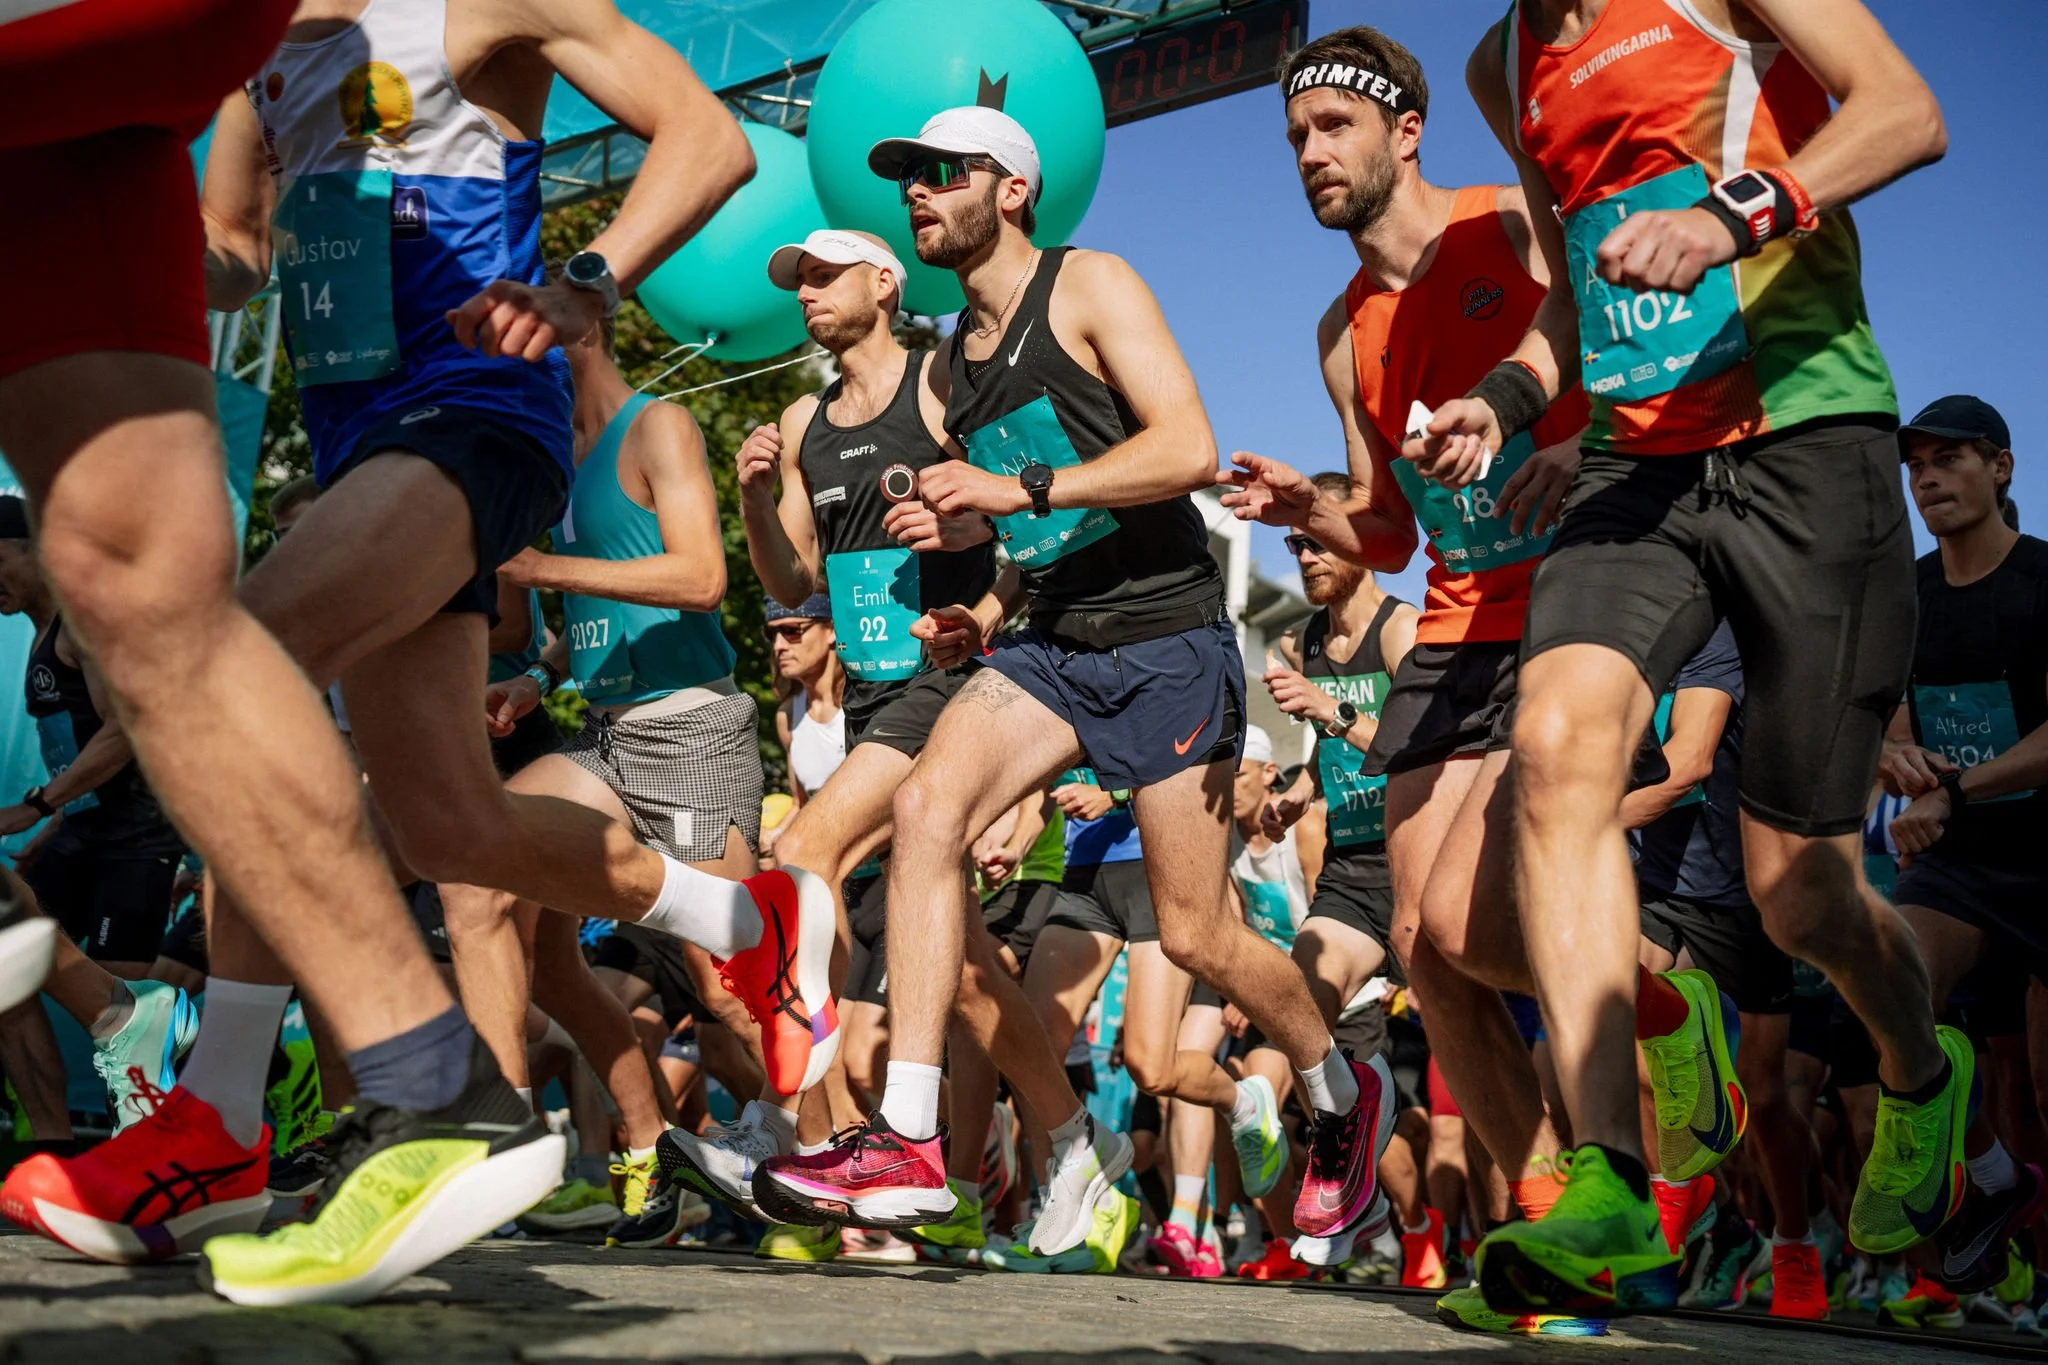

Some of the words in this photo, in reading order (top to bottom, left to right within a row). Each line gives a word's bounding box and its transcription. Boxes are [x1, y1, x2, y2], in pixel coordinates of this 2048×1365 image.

[1569, 23, 1675, 90] SOLVIKINGARNA
[1288, 63, 1403, 109] TRIMTEX
[284, 233, 361, 267] Gustav
[300, 280, 334, 321] 14
[1463, 287, 1503, 317] RUNNERS
[1603, 291, 1693, 341] 1102
[1590, 373, 1626, 394] HOKA
[840, 445, 870, 460] CRAFT
[1013, 546, 1038, 563] HOKA
[1443, 548, 1469, 560] HOKA
[853, 582, 890, 607] Emil
[571, 618, 609, 651] 2127
[859, 615, 889, 642] 22
[1936, 713, 1991, 736] Alfred
[1342, 786, 1385, 811] 1712
